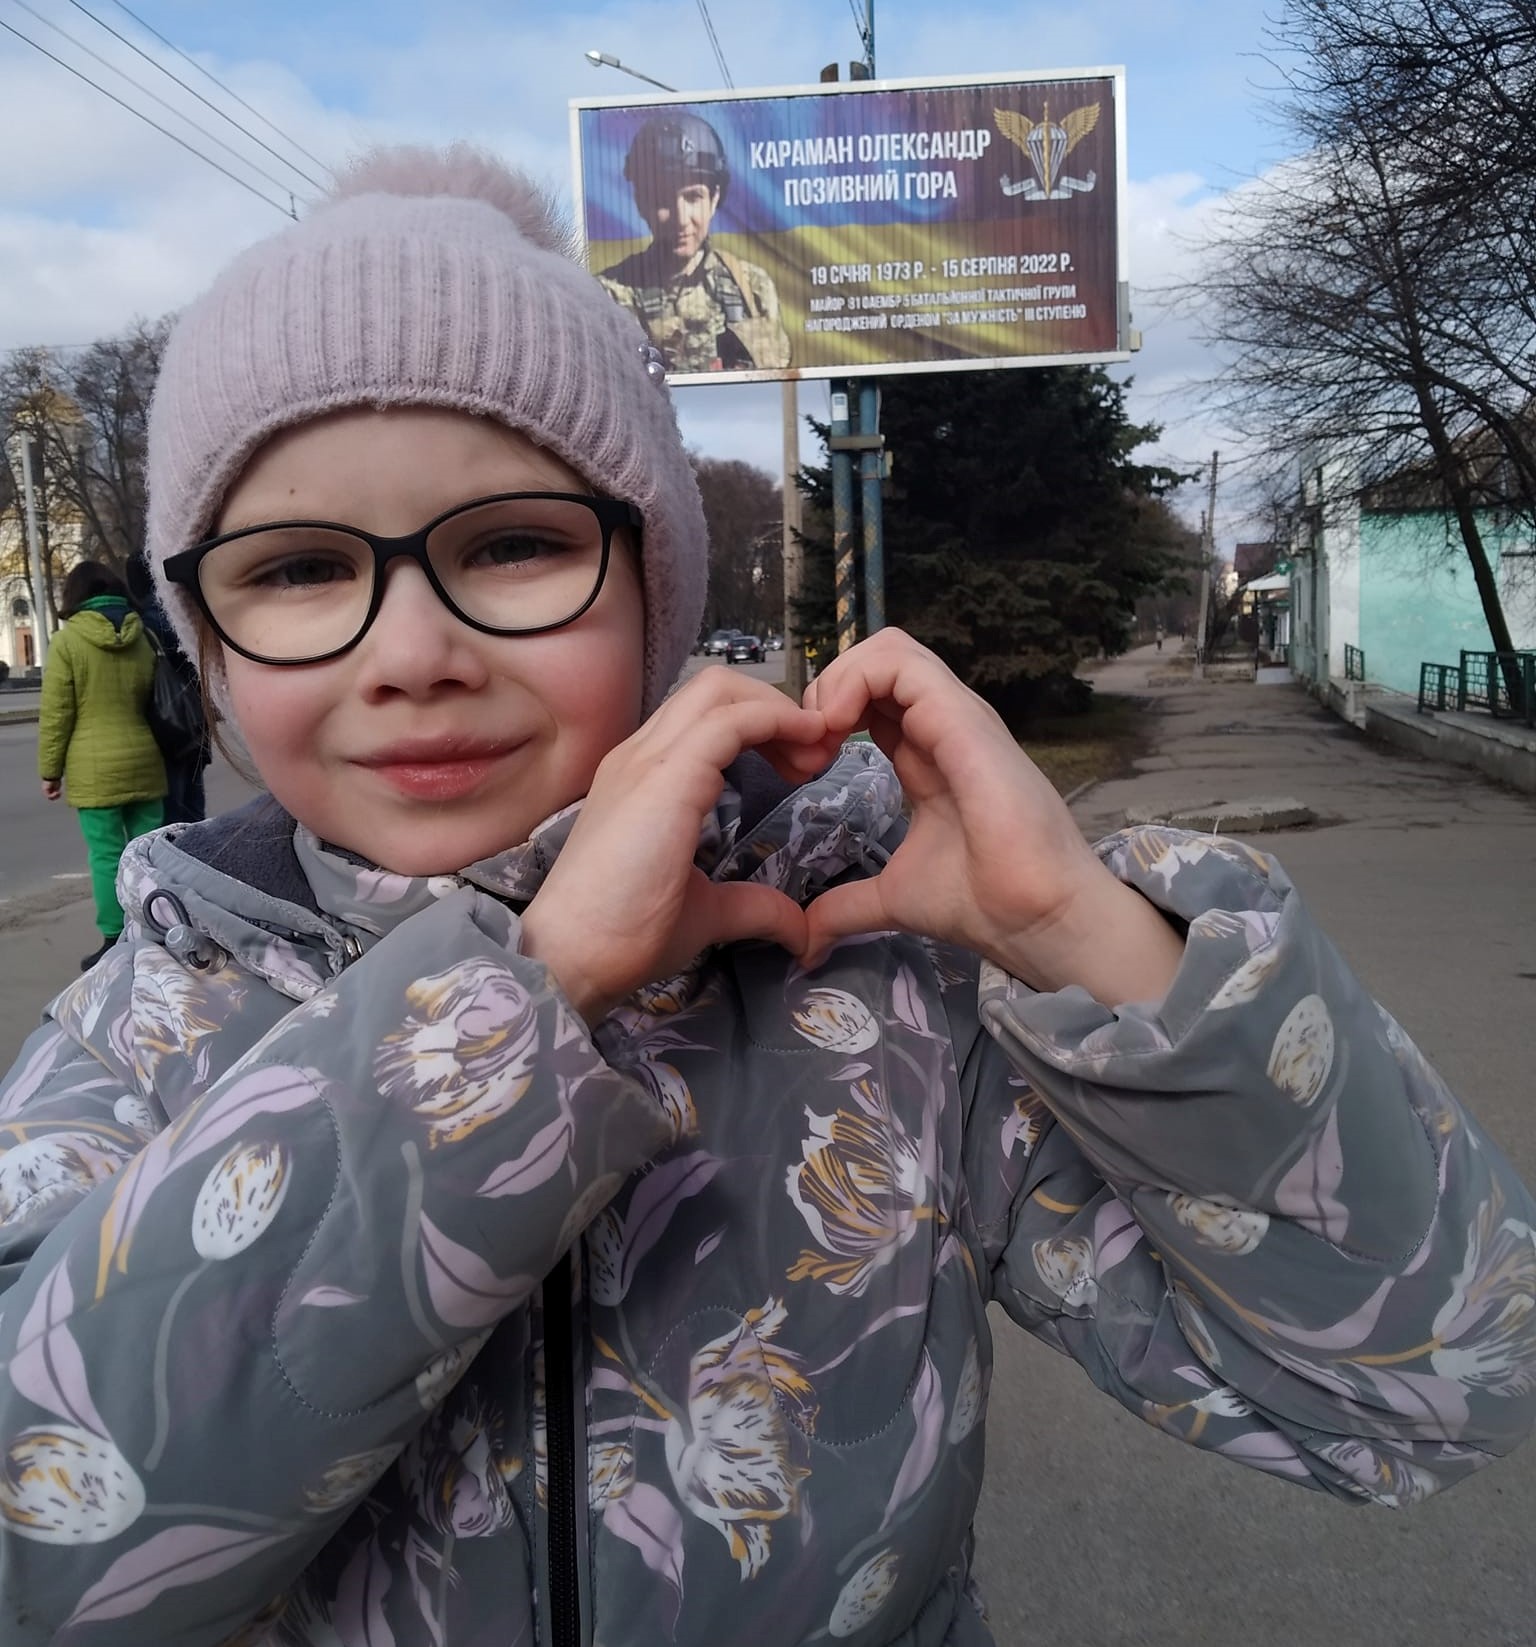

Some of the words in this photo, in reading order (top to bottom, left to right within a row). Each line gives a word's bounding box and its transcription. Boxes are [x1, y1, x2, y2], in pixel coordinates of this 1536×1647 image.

[751, 136, 853, 168] КАРАМАН
[858, 128, 991, 162] ОЛЕКСАНДР
[784, 169, 898, 206] ПОЗИВНИЙ
[905, 170, 958, 200] ГОРА
[810, 266, 827, 285] 19
[830, 264, 871, 283] СІЧНЯ
[876, 261, 910, 281] 1973
[913, 260, 927, 279] Р.
[942, 259, 959, 278] 15
[961, 255, 1018, 277] СЕРПНЯ
[1020, 253, 1057, 274] 2022
[1060, 252, 1075, 272] Р.
[1043, 285, 1076, 299] ГРУПИ
[890, 313, 939, 328] ОРДЕНОМ
[1036, 304, 1086, 320] СТУПЕНЮ
